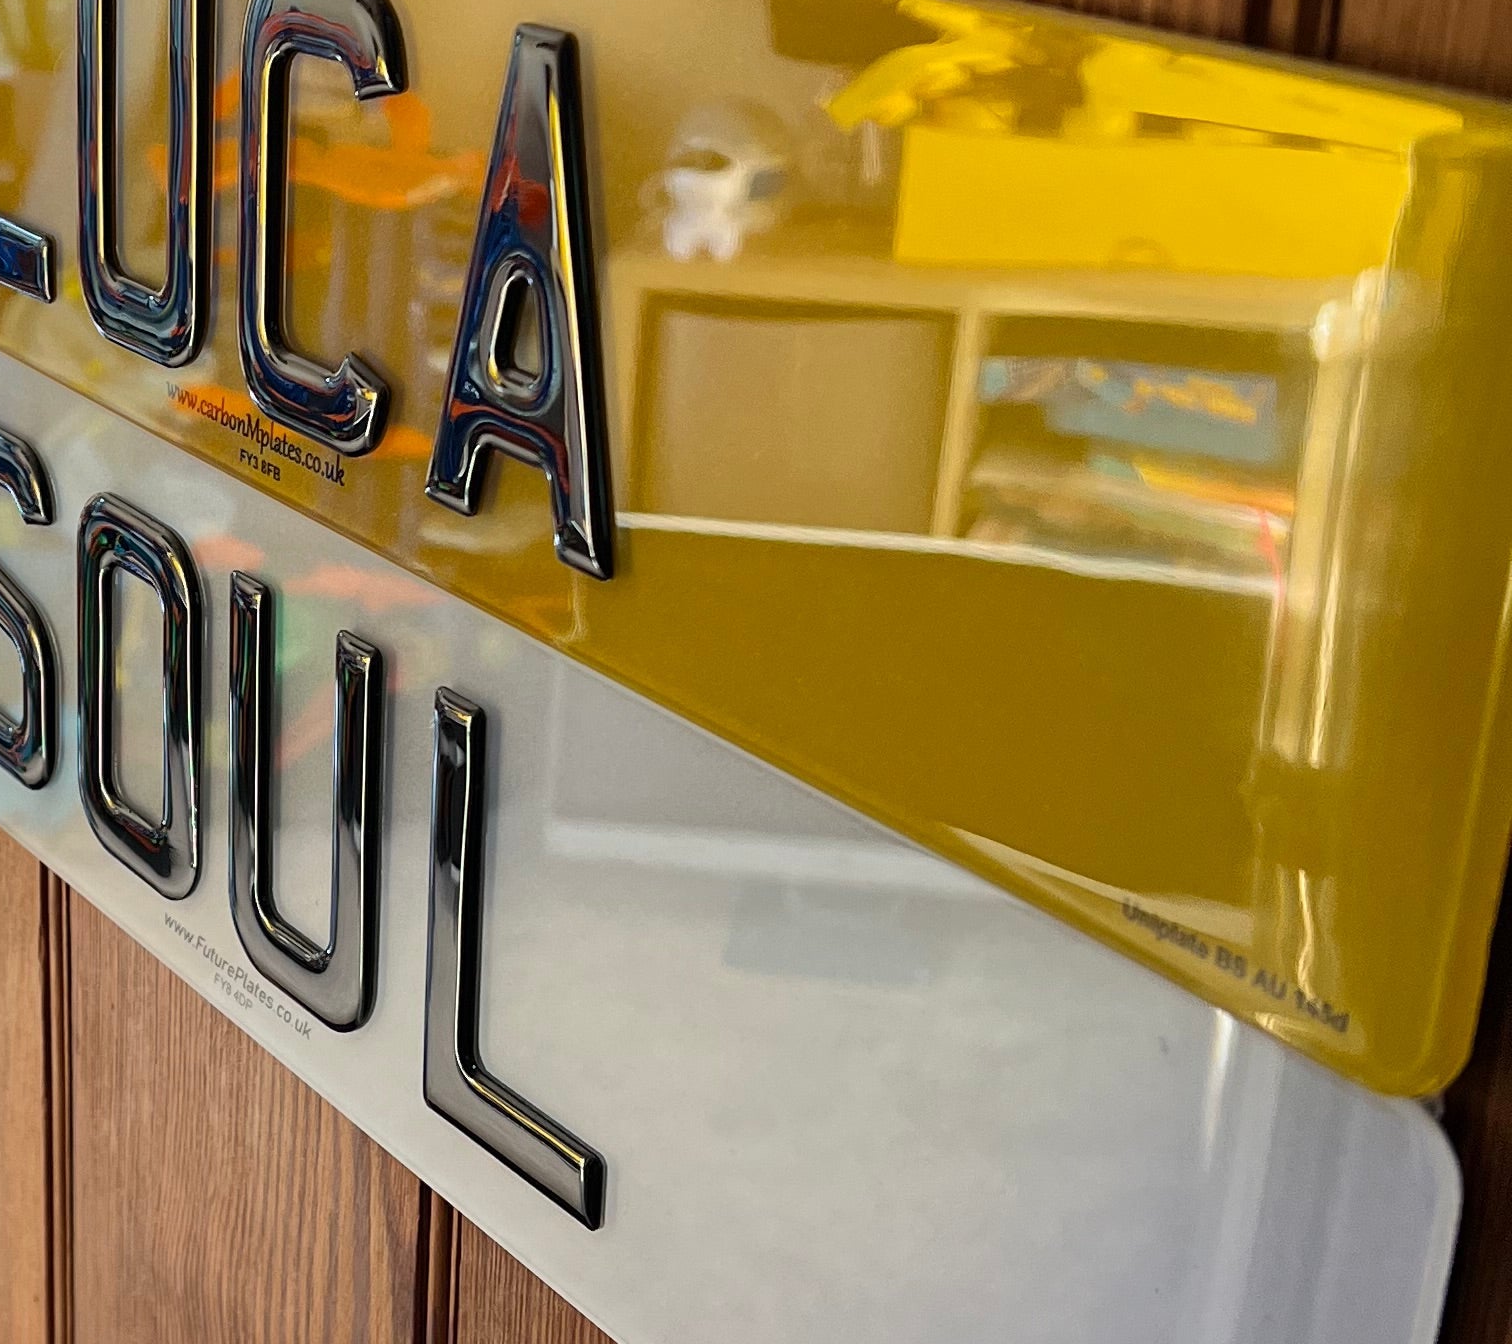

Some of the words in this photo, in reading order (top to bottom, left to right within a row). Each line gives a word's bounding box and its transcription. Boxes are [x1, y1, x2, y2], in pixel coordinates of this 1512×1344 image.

[166, 380, 345, 487] www.carbonMplates.co.uk
[239, 448, 258, 470] FY3
[164, 912, 312, 1040] www.FuturePlates.co.uk
[1251, 968, 1287, 1000] AU
